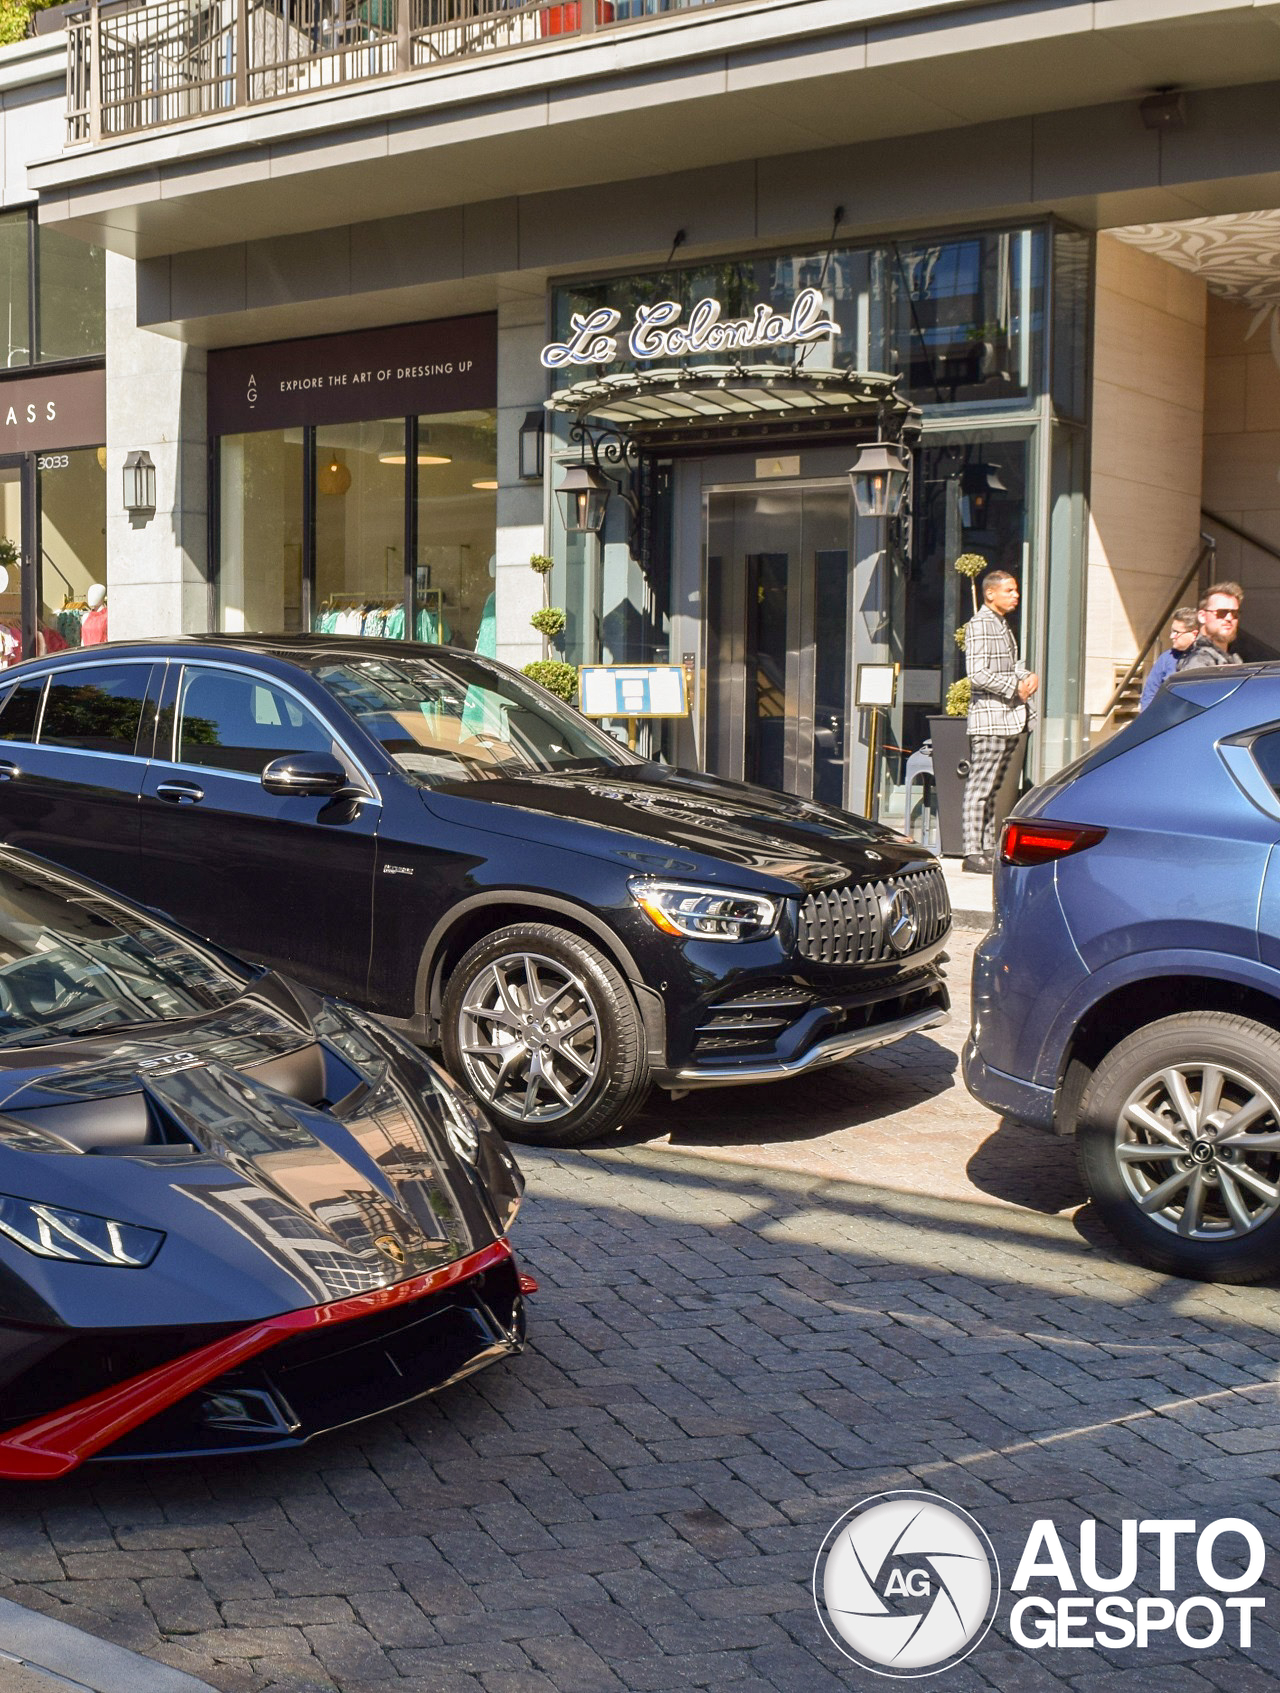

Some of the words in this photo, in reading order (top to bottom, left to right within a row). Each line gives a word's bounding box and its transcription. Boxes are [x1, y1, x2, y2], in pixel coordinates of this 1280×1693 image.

[540, 307, 621, 369] Le
[628, 287, 843, 360] Colonial
[280, 377, 324, 392] EXPLORE
[328, 374, 348, 387] THE
[352, 371, 372, 384] ART
[377, 369, 393, 382] OF
[397, 362, 454, 380] DRESSING
[458, 360, 474, 373] UP
[37, 454, 70, 470] 3033
[137, 1052, 195, 1069] STO
